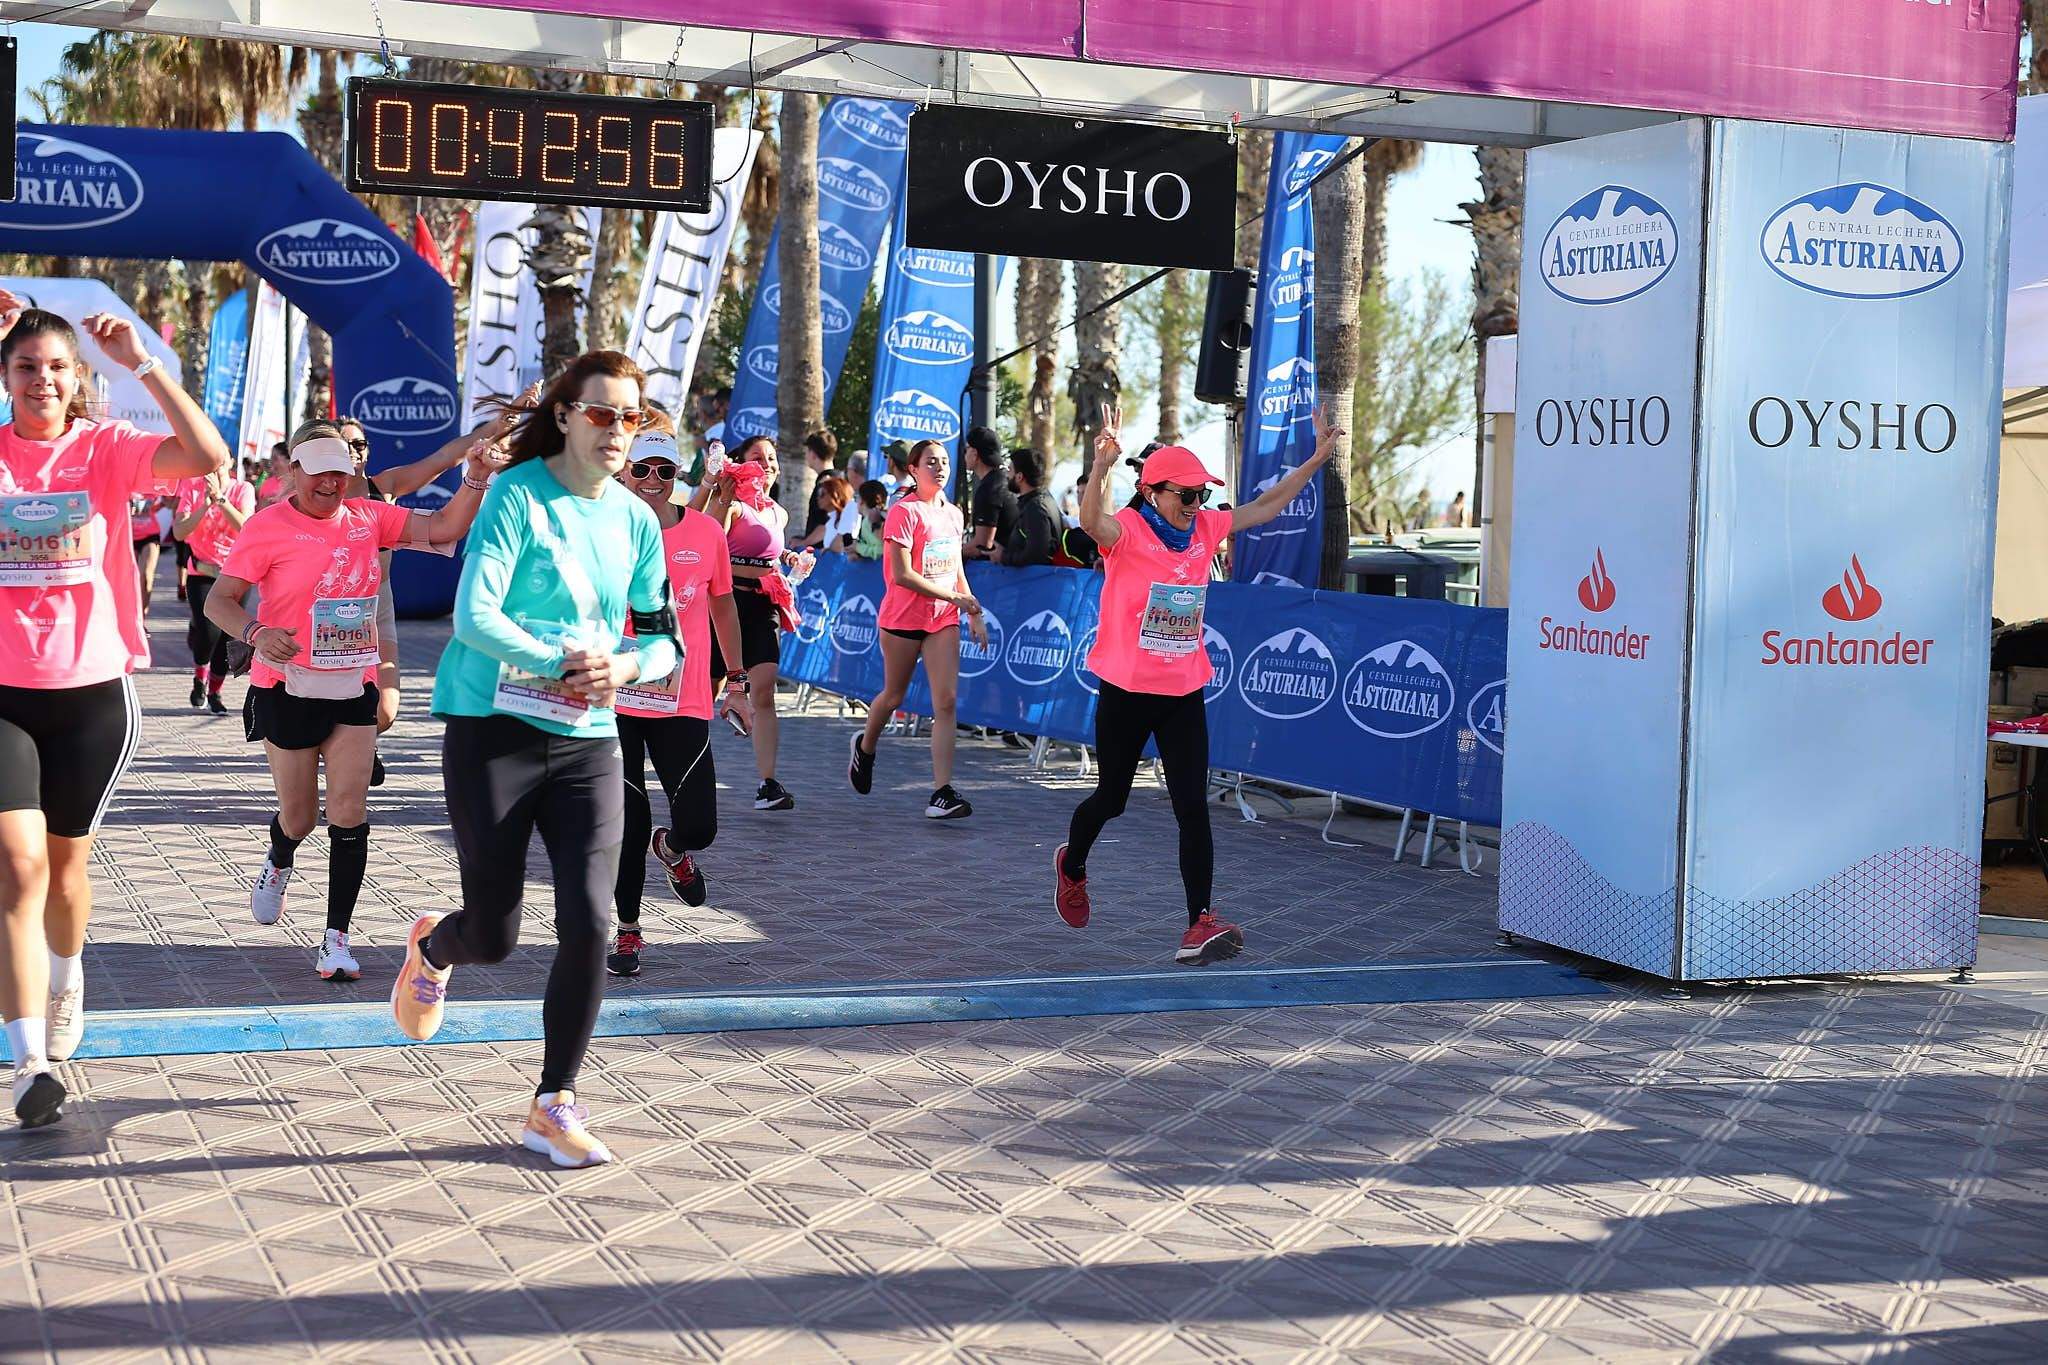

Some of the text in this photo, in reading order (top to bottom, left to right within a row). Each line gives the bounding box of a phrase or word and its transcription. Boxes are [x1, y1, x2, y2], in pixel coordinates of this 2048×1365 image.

[375, 100, 686, 189] 00:42:56
[41, 162, 118, 177] LECHERA
[16, 177, 126, 209] RIANA
[964, 157, 1191, 221] OYSHO
[1569, 220, 1663, 242] CENTRAL LECHERA
[1808, 220, 1942, 239] CENTRAL LECHERA
[269, 242, 392, 268] ASTURIANA
[902, 248, 975, 278] ASTURIAN
[1548, 235, 1667, 278] ASTURIANA
[1775, 221, 1947, 273] ASTURIANA
[644, 186, 727, 412] YSHO
[121, 408, 165, 420] OYSH
[358, 398, 452, 421] ASTURIANA
[1536, 396, 1670, 447] OYSHO
[1748, 397, 1957, 453] OYSHO
[1009, 637, 1065, 668] ASTURIANA
[1539, 617, 1650, 660] Santander
[1761, 630, 1934, 665] Santander
[1244, 658, 1327, 700] ASTURIANA
[1265, 657, 1329, 672] CENTRAL LECHERA
[1369, 671, 1441, 689] CENTRAL LECHERA
[1348, 670, 1440, 719] ASTURIANA
